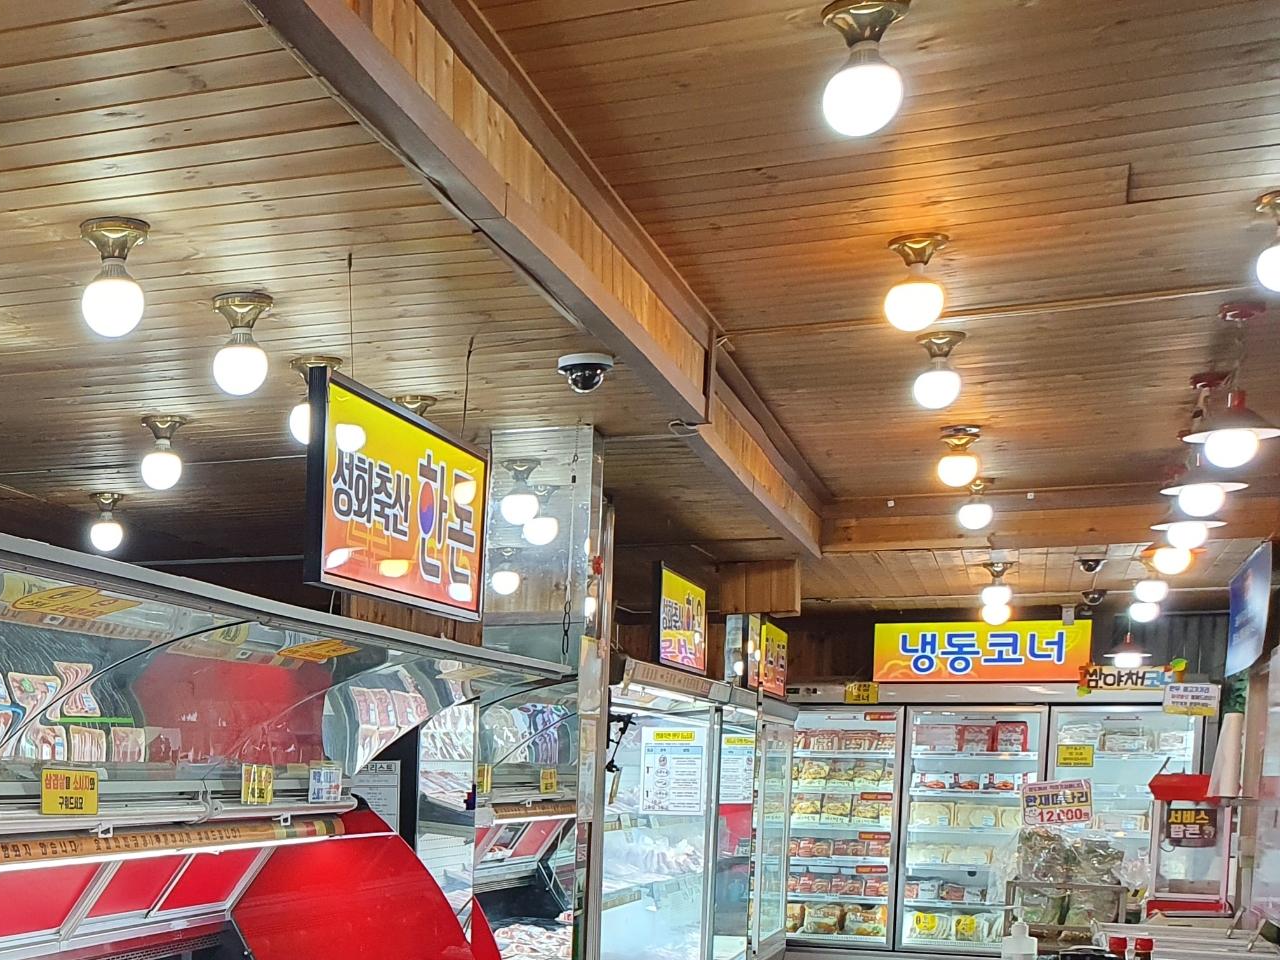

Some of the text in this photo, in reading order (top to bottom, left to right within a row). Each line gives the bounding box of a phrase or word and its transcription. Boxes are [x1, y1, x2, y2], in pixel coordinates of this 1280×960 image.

[900, 630, 1067, 675] 냉동코너
[1168, 810, 1209, 823] 서비스
[1170, 824, 1202, 838] 팝콘
